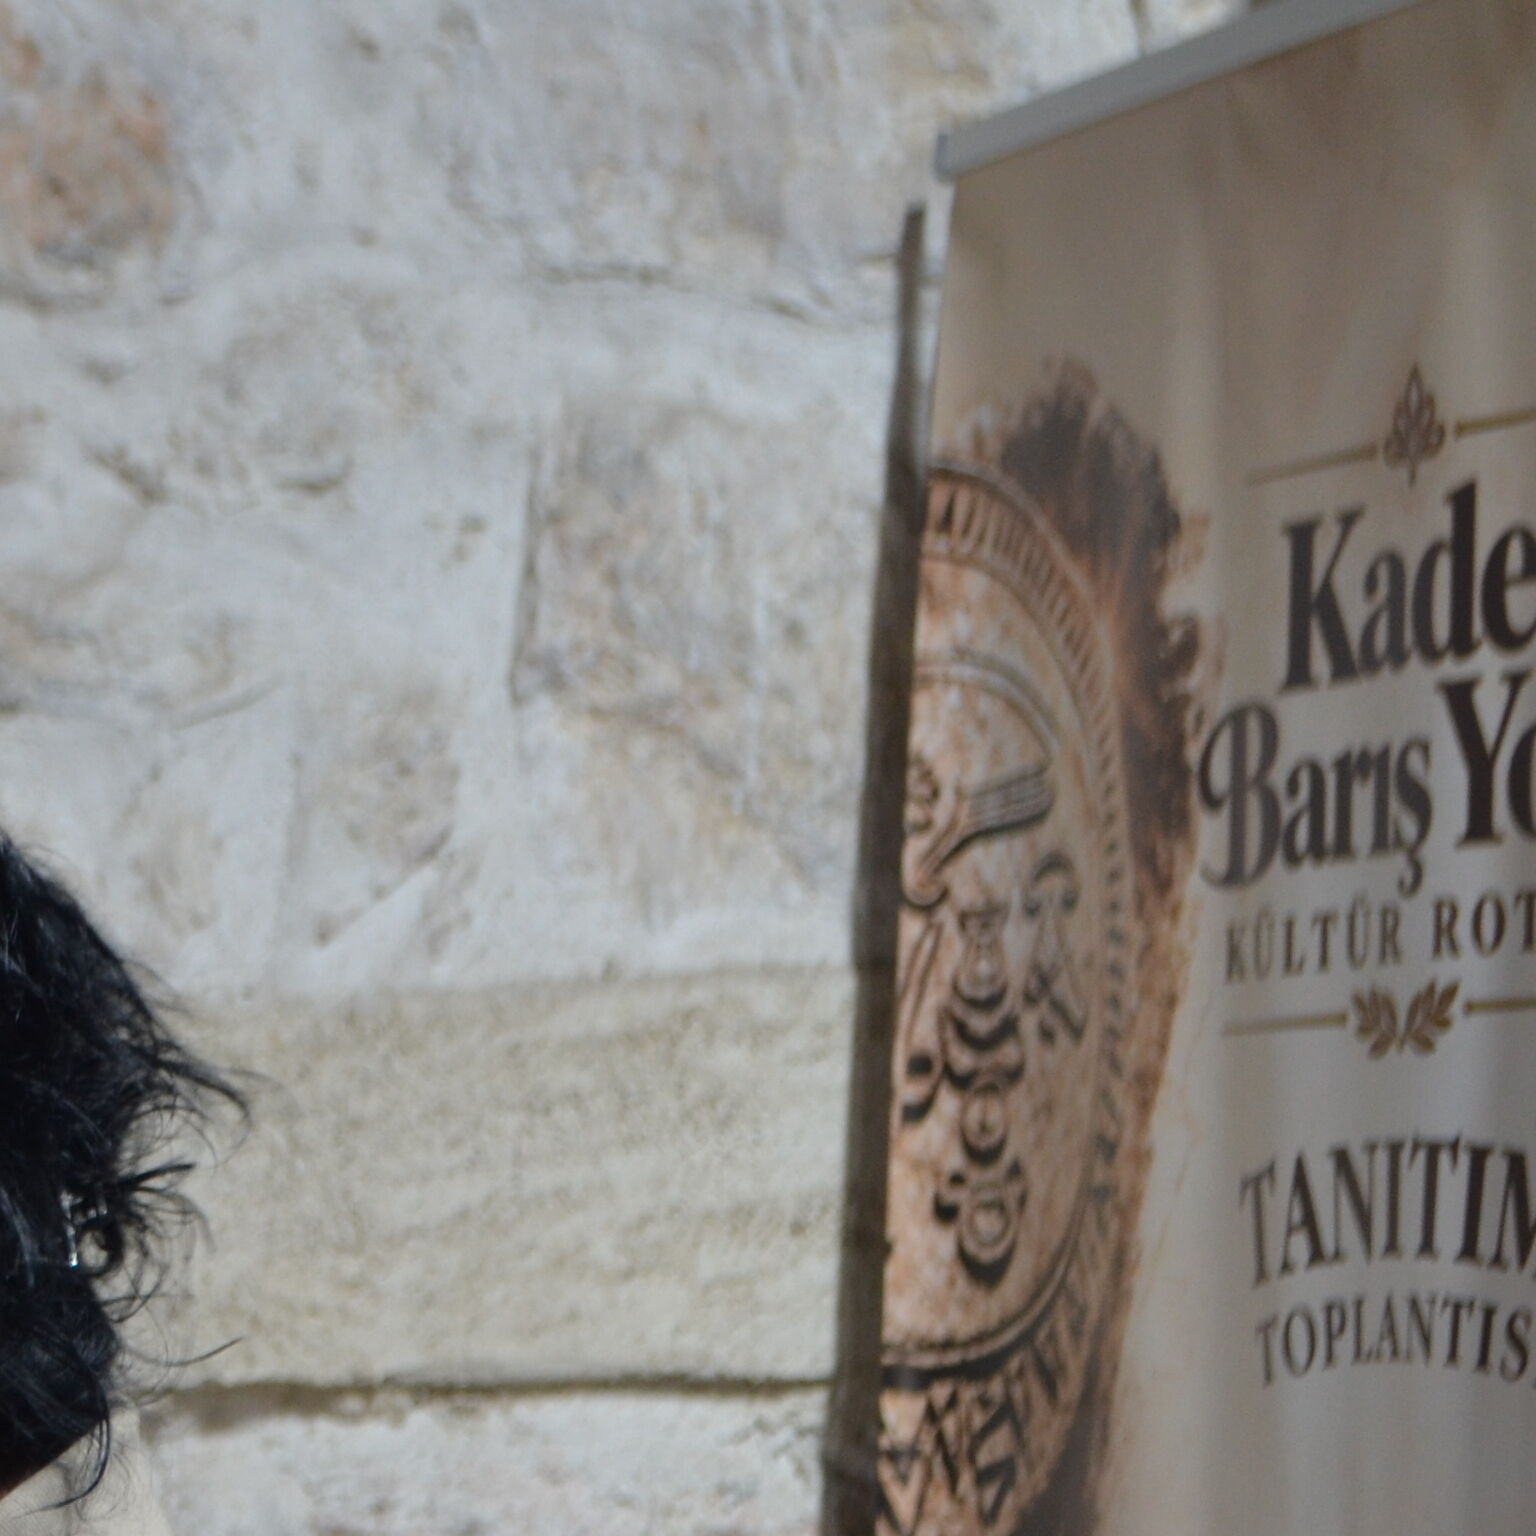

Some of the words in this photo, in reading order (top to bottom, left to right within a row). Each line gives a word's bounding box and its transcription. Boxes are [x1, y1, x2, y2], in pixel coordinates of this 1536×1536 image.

[1279, 479, 1536, 694] Kade
[1199, 702, 1432, 897] Barış
[1225, 895, 1402, 984] KÜLTÜR
[1255, 1294, 1536, 1388] TOPLANTIS
